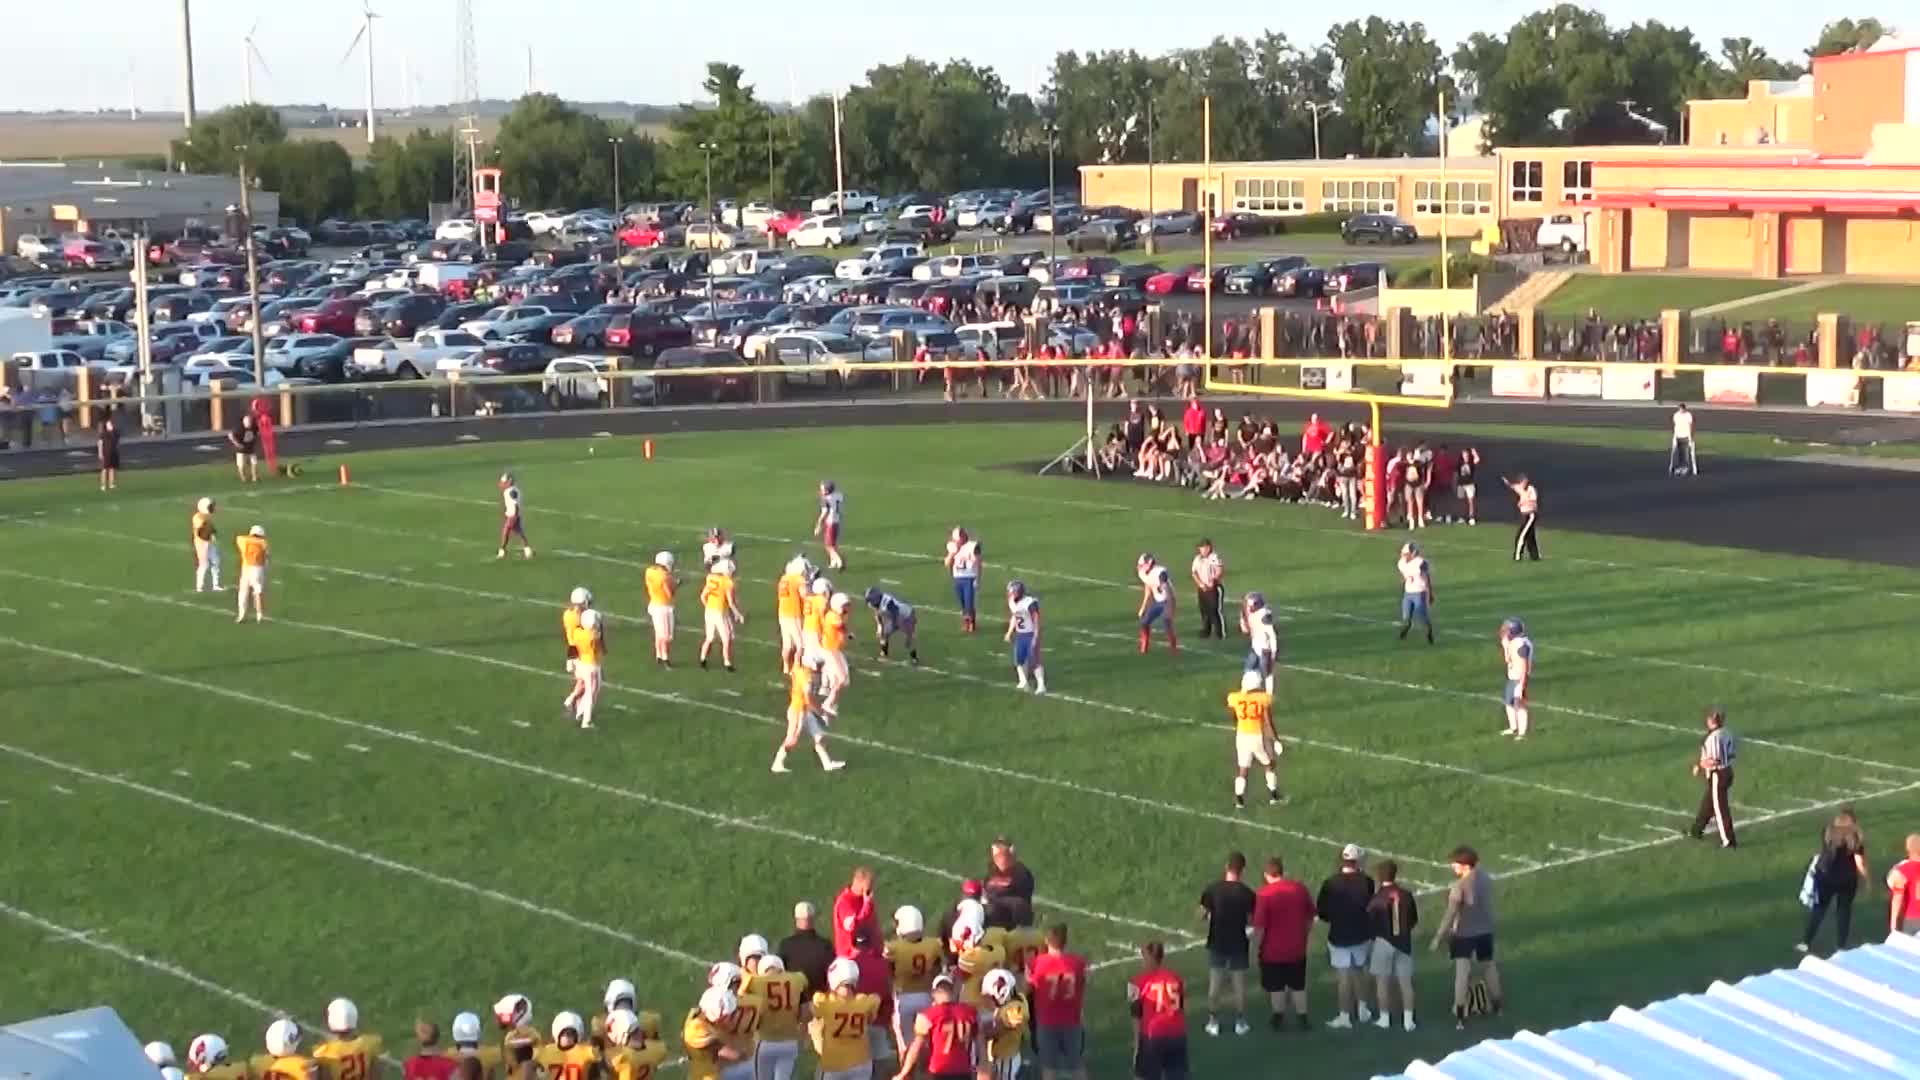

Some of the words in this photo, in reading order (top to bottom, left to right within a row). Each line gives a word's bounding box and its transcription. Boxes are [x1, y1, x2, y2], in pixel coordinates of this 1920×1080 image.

[1238, 700, 1260, 720] 33
[912, 953, 927, 976] 9
[767, 981, 793, 1011] 51
[832, 1012, 866, 1039] 79
[341, 1052, 366, 1080] 21
